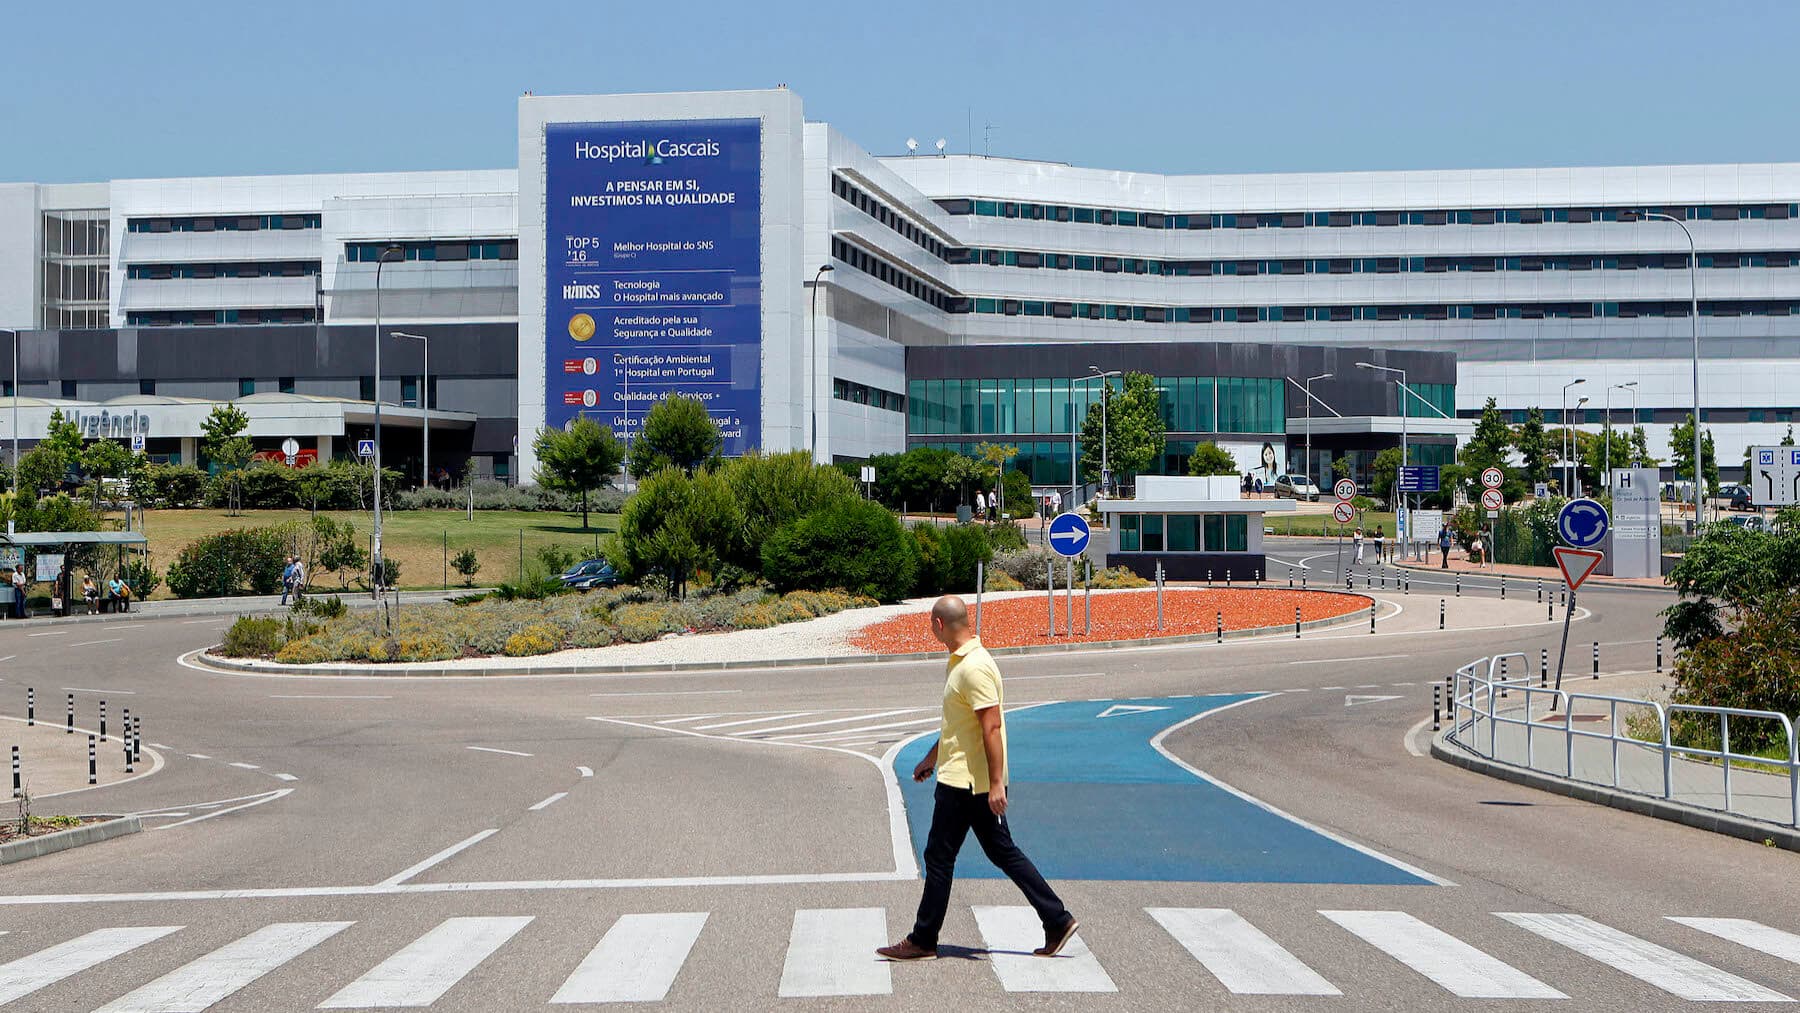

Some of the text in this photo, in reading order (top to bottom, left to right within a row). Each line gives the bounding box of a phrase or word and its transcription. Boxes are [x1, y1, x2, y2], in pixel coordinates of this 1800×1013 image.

[575, 138, 720, 162] Hospital Cascais
[606, 180, 700, 192] A PENSAR EM SI,
[571, 193, 736, 206] INVESTIMOS NA QUALIDADE
[566, 237, 600, 248] TOP 5
[614, 240, 714, 252] Melhor Hospital do SNS
[614, 280, 660, 290] Tecnologia
[614, 291, 724, 302] O Hospital mais avançado
[614, 316, 660, 325] Acreditado
[662, 316, 681, 326] pela
[614, 328, 658, 339] Segurança
[668, 328, 712, 337] Qualidade
[614, 354, 710, 366] Certificação Ambiental
[626, 367, 660, 378] Hospital
[678, 366, 714, 378] Portugal
[614, 391, 712, 402] Qualidade do Serviços
[66, 409, 150, 437] Urgência
[614, 416, 638, 426] Únco
[734, 417, 740, 425] a
[717, 428, 742, 438] ward
[1485, 474, 1500, 483] 30
[1620, 472, 1630, 488] H
[1338, 486, 1352, 494] 30
